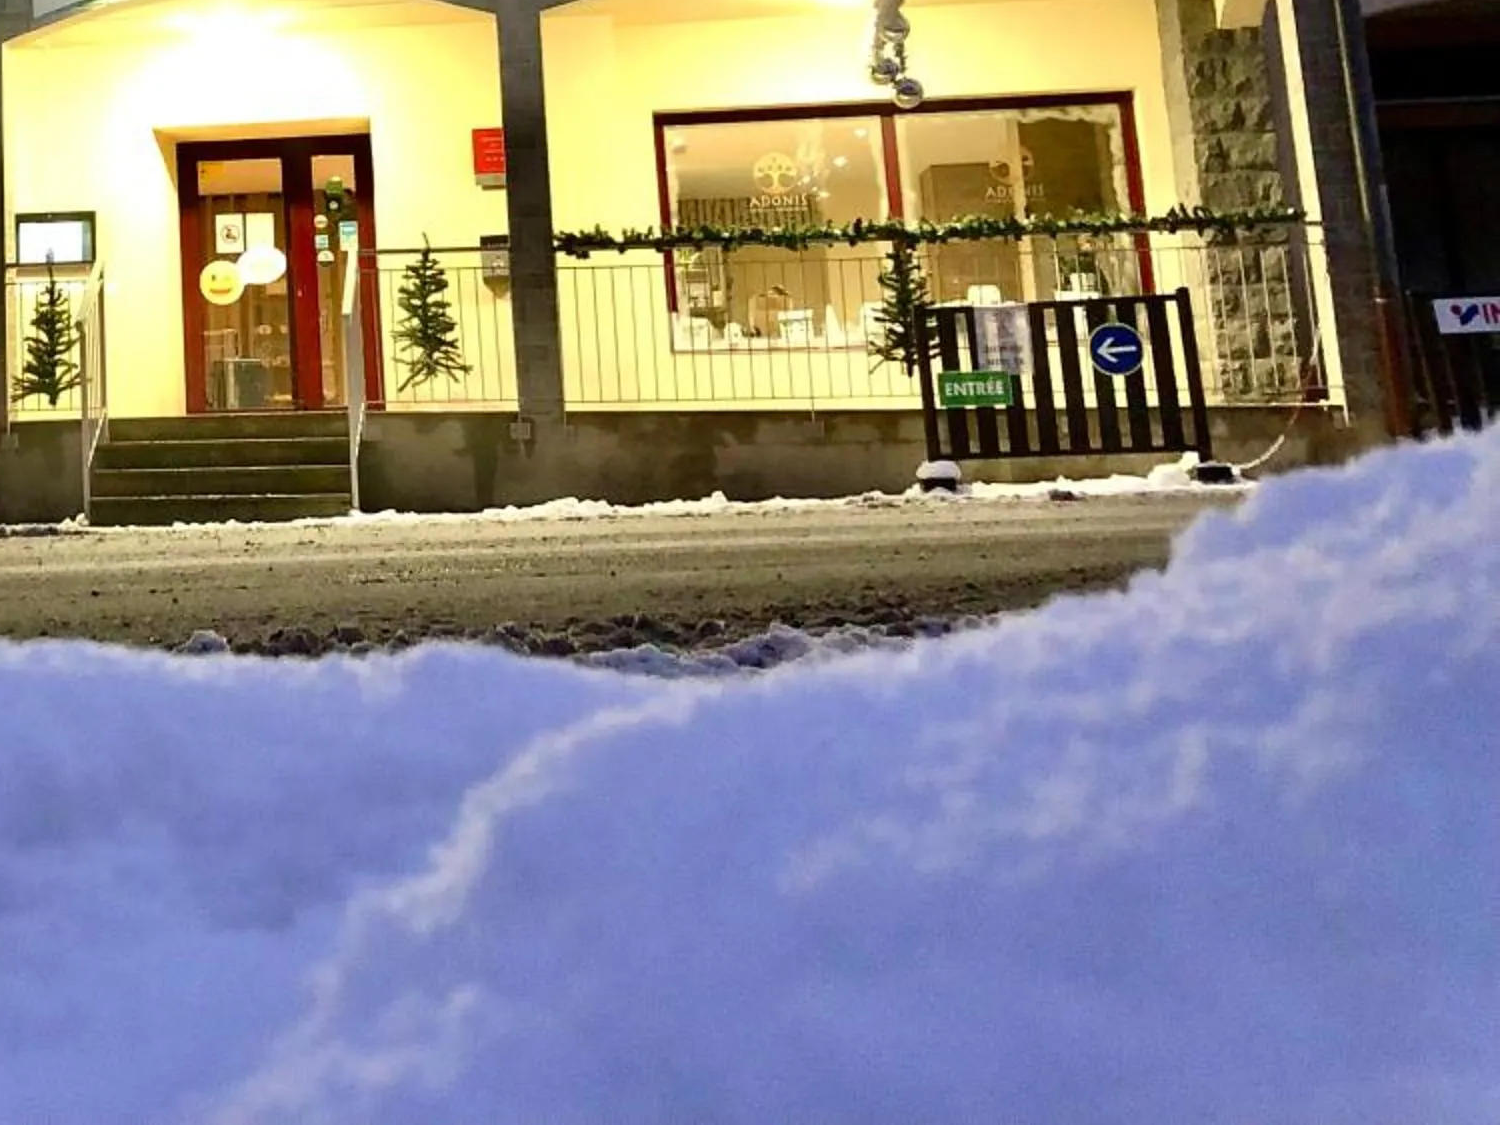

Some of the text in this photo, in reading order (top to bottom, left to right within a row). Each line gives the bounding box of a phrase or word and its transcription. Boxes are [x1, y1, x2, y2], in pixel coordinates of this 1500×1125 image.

[985, 184, 1044, 198] ADIS
[749, 194, 808, 209] ADONIS
[944, 377, 1005, 396] ENTRÉE
